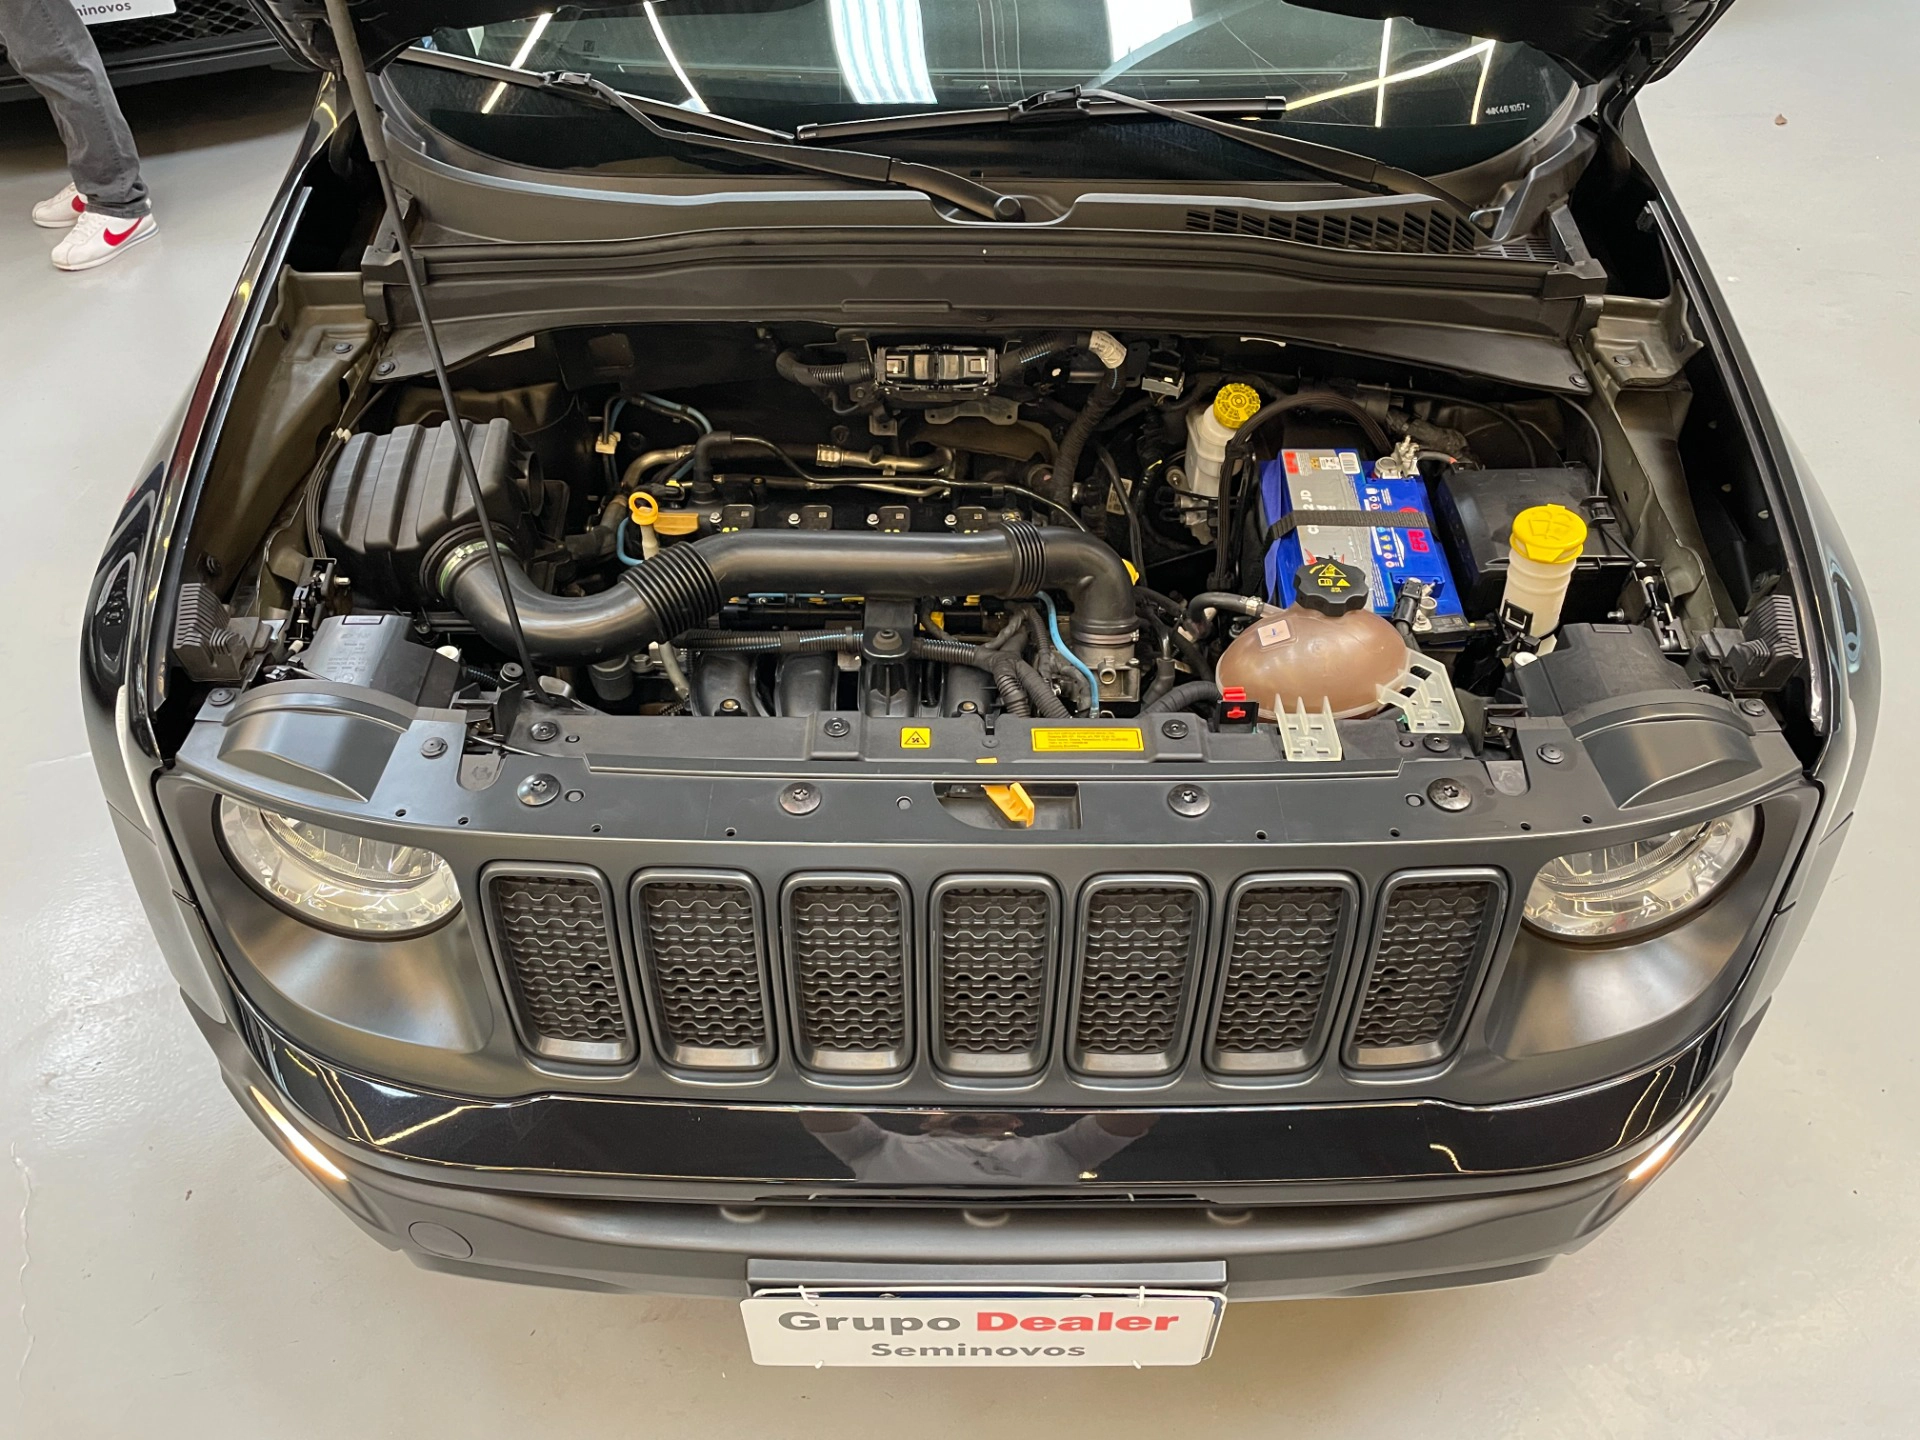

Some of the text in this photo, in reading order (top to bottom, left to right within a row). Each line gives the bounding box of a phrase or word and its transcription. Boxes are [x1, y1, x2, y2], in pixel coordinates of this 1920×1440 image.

[76, 2, 132, 17] inovos
[778, 1311, 1180, 1336] Grupo Dealer
[870, 1342, 1086, 1358] Seminovos
